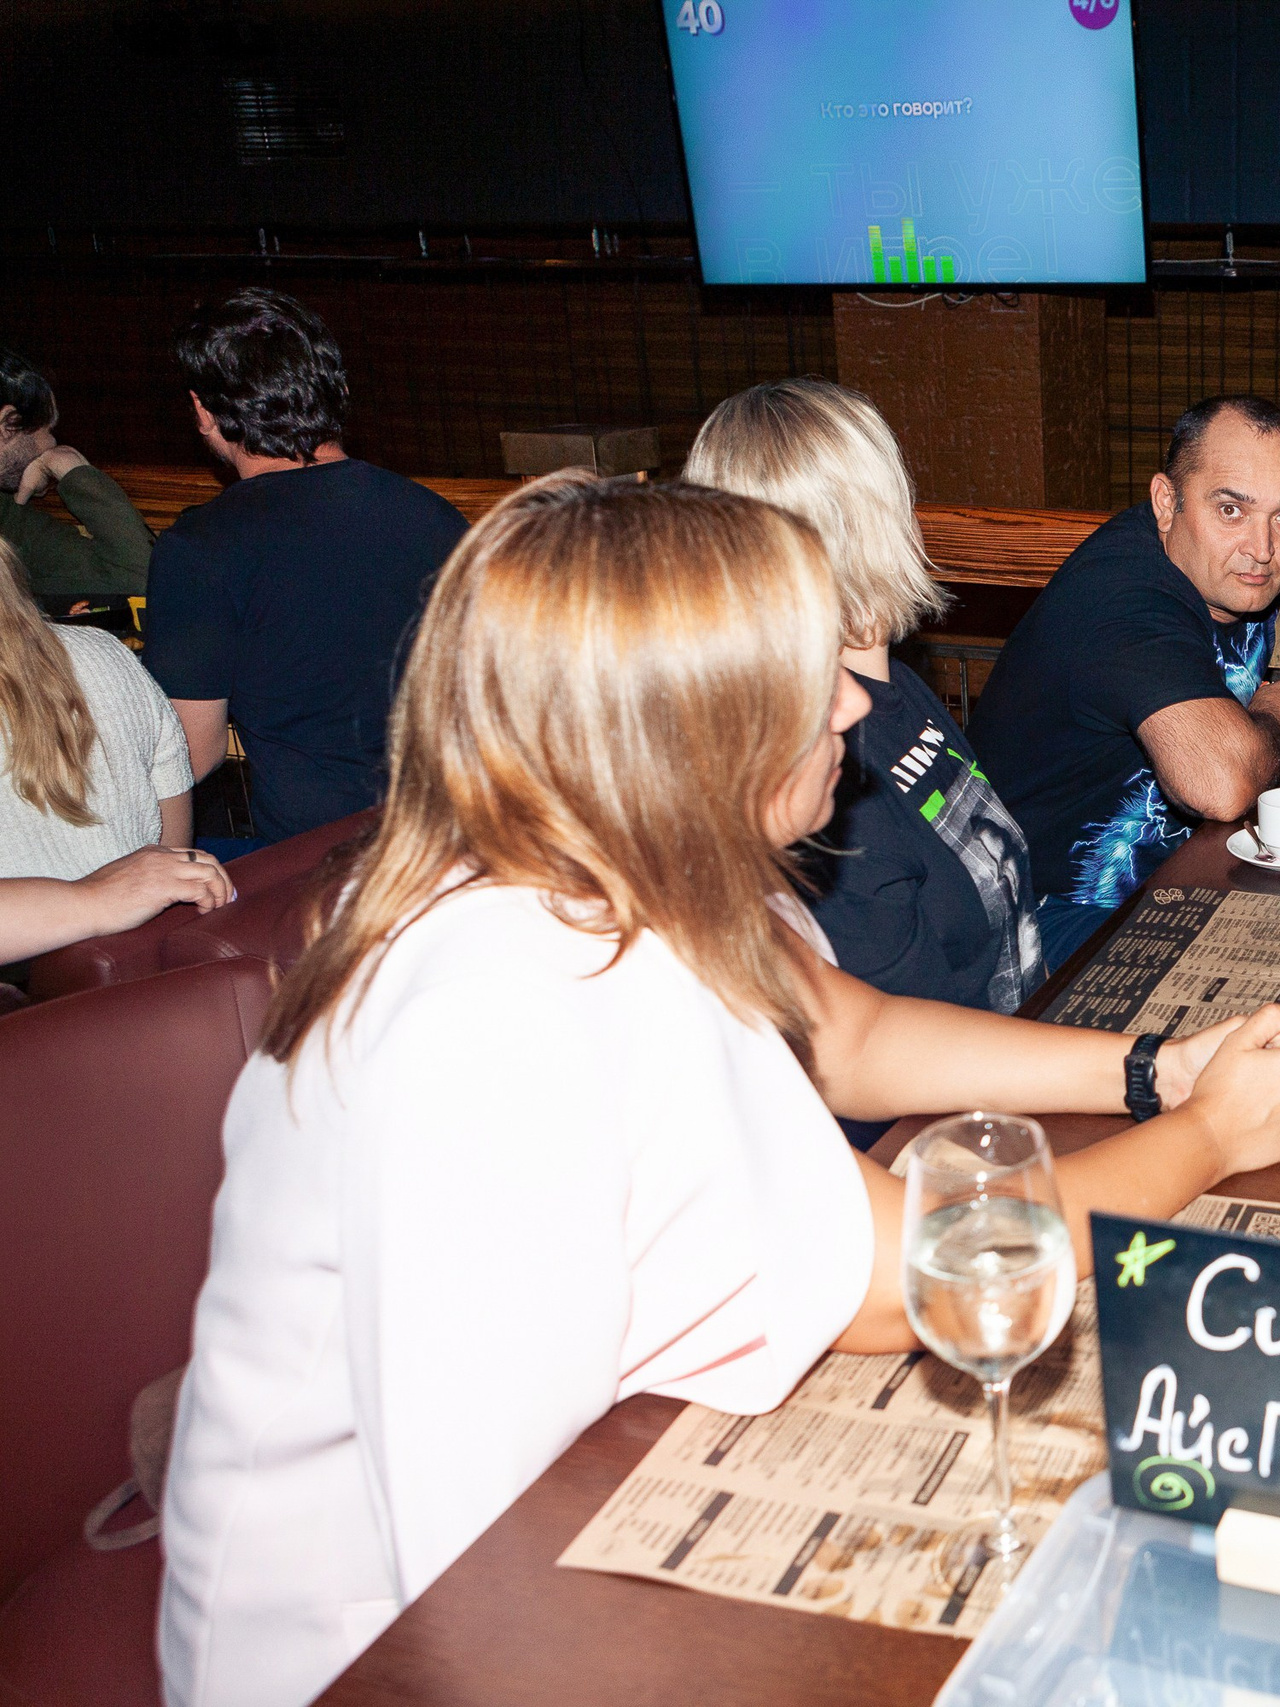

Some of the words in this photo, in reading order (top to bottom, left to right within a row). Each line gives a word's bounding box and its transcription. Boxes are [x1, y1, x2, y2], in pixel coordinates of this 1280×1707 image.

[676, 0, 724, 35] 40
[820, 102, 853, 119] Кто
[858, 102, 889, 118] это
[893, 97, 973, 119] говорит?
